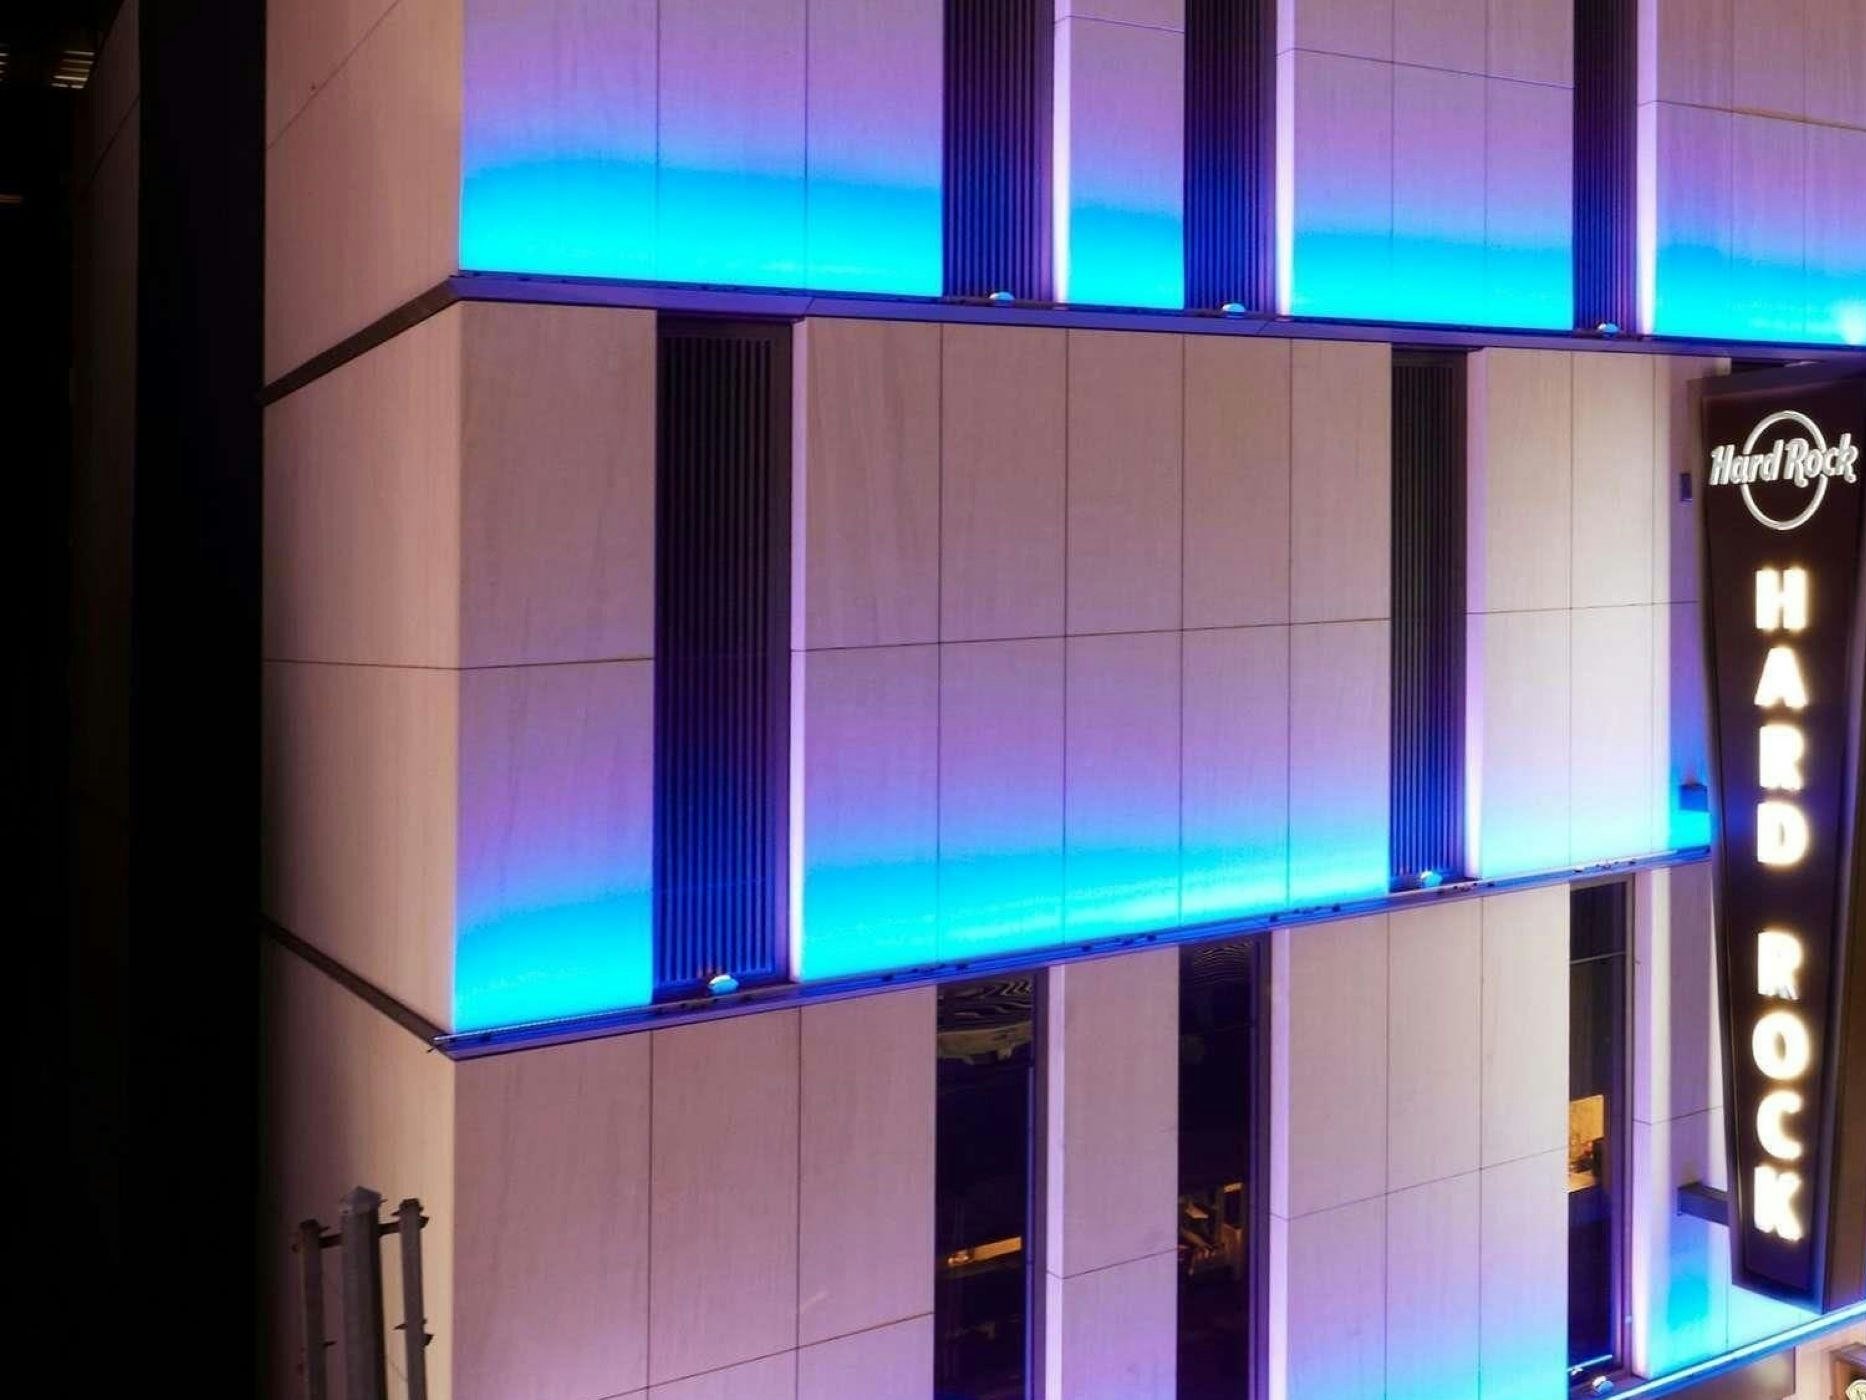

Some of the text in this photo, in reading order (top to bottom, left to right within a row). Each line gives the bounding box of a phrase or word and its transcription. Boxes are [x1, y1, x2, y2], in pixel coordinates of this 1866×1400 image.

[1709, 433, 1859, 488] Hard Rock
[1752, 567, 1811, 1242] HARD ROCK
